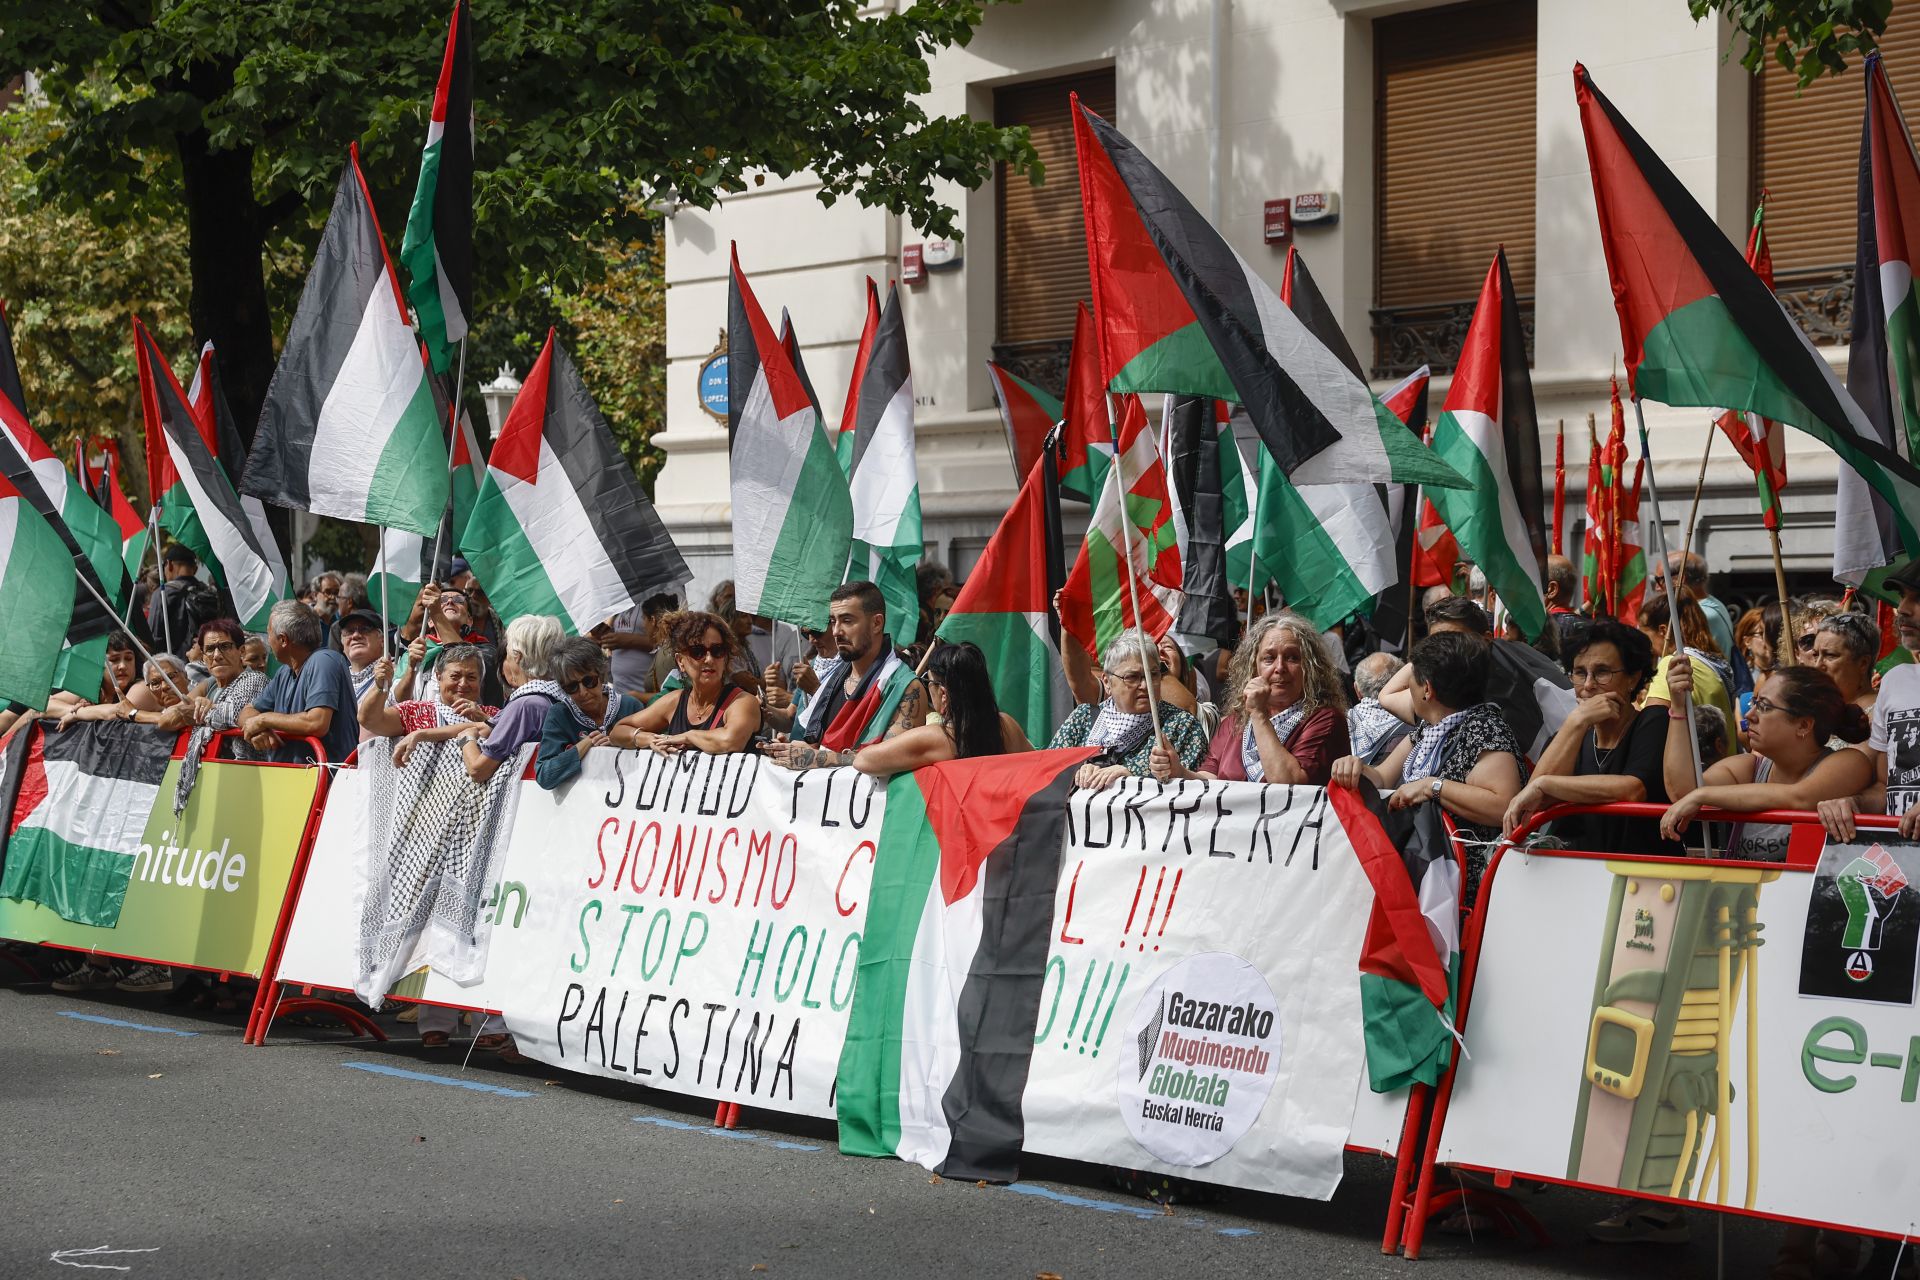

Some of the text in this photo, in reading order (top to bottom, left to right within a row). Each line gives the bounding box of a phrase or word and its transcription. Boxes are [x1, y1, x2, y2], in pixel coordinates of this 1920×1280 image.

[1297, 195, 1320, 207] ABRA
[129, 830, 246, 893] nitude
[588, 816, 798, 911] SIONISMO
[570, 899, 709, 986] STOP
[1167, 991, 1274, 1040] Gazarako
[557, 983, 801, 1101] PALESTINA
[1158, 1030, 1270, 1075] Mugimendu
[1148, 1063, 1230, 1107] Globala
[1142, 1098, 1224, 1132] Euskal Herria
